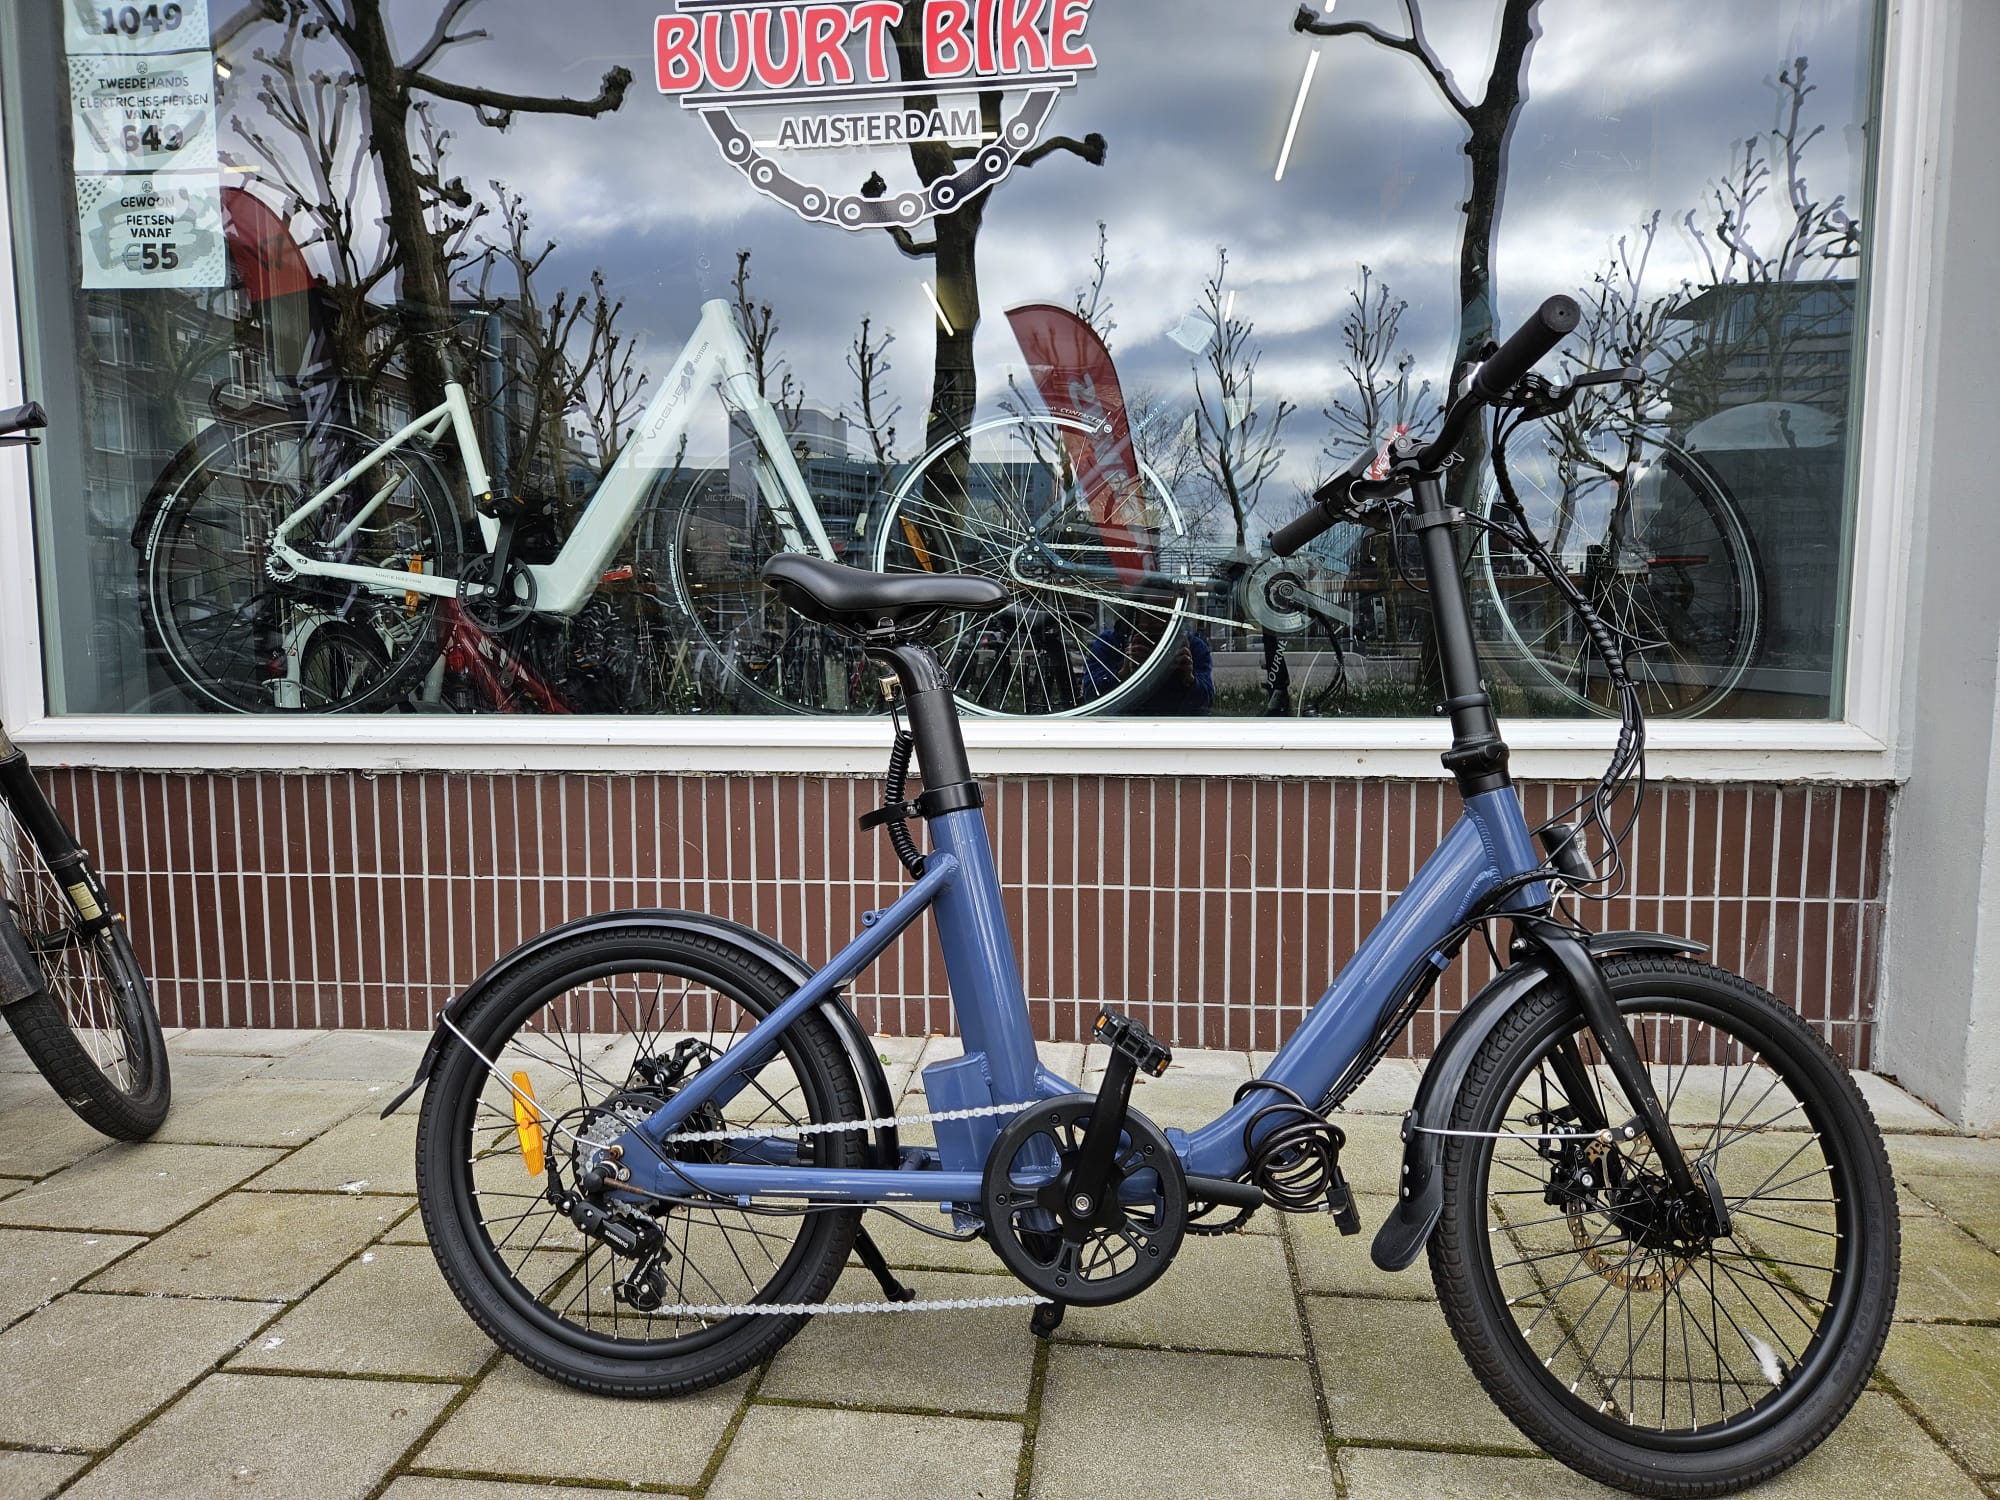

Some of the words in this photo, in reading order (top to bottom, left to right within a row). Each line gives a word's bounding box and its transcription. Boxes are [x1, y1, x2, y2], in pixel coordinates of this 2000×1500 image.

[101, 3, 182, 34] 1049
[655, 2, 902, 93] BUURT
[922, 0, 1095, 77] BIKE
[98, 77, 190, 89] TWEEDEHANDS
[162, 93, 208, 107] FIETSEN
[125, 109, 166, 119] VANAF
[779, 109, 977, 146] AMSTERDAM
[120, 196, 174, 207] GEWOON
[126, 214, 174, 226] FIETSEN
[130, 228, 171, 238] VANAF
